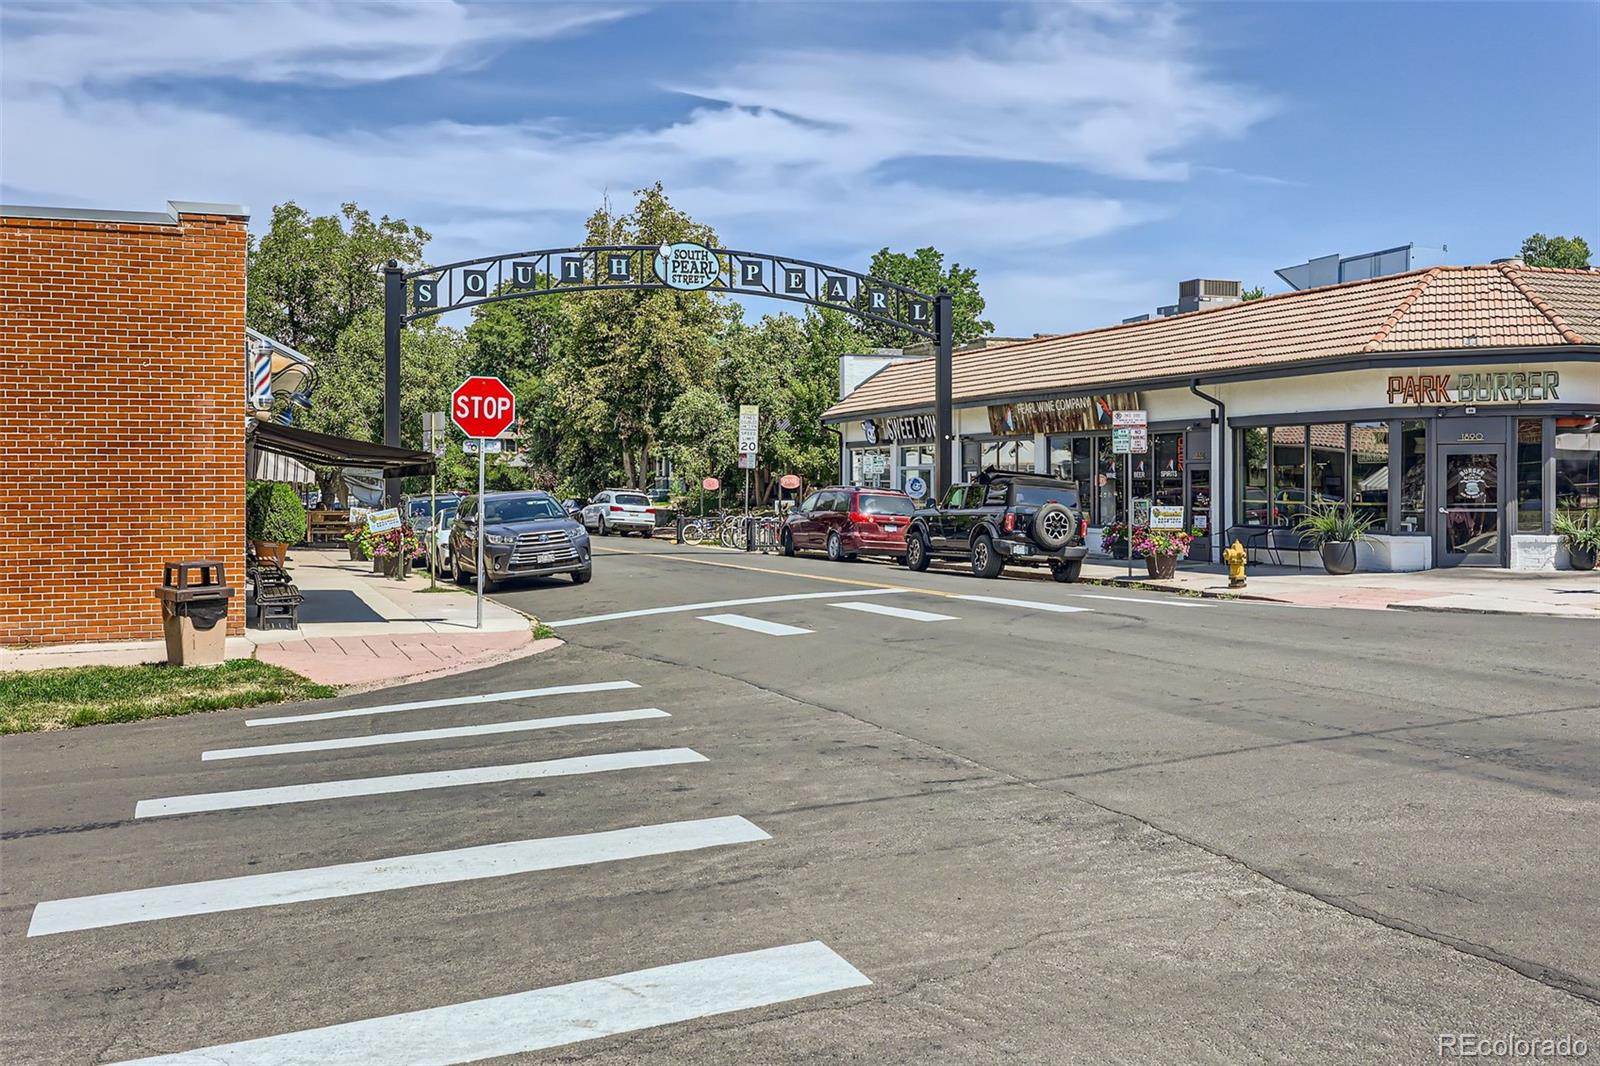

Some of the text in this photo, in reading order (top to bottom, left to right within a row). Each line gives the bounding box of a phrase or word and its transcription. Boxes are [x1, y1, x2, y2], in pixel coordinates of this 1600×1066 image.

[674, 249, 709, 261] SOUTH
[672, 260, 717, 279] PEARL
[672, 274, 705, 285] STREET
[1387, 371, 1560, 404] PARK BURGER
[456, 395, 511, 420] STOP
[1016, 396, 1091, 415] PEARL WINE COMPANY
[887, 416, 917, 440] SWEET
[1461, 432, 1484, 441] 1890
[741, 442, 756, 451] 20
[1459, 467, 1485, 477] BURGER
